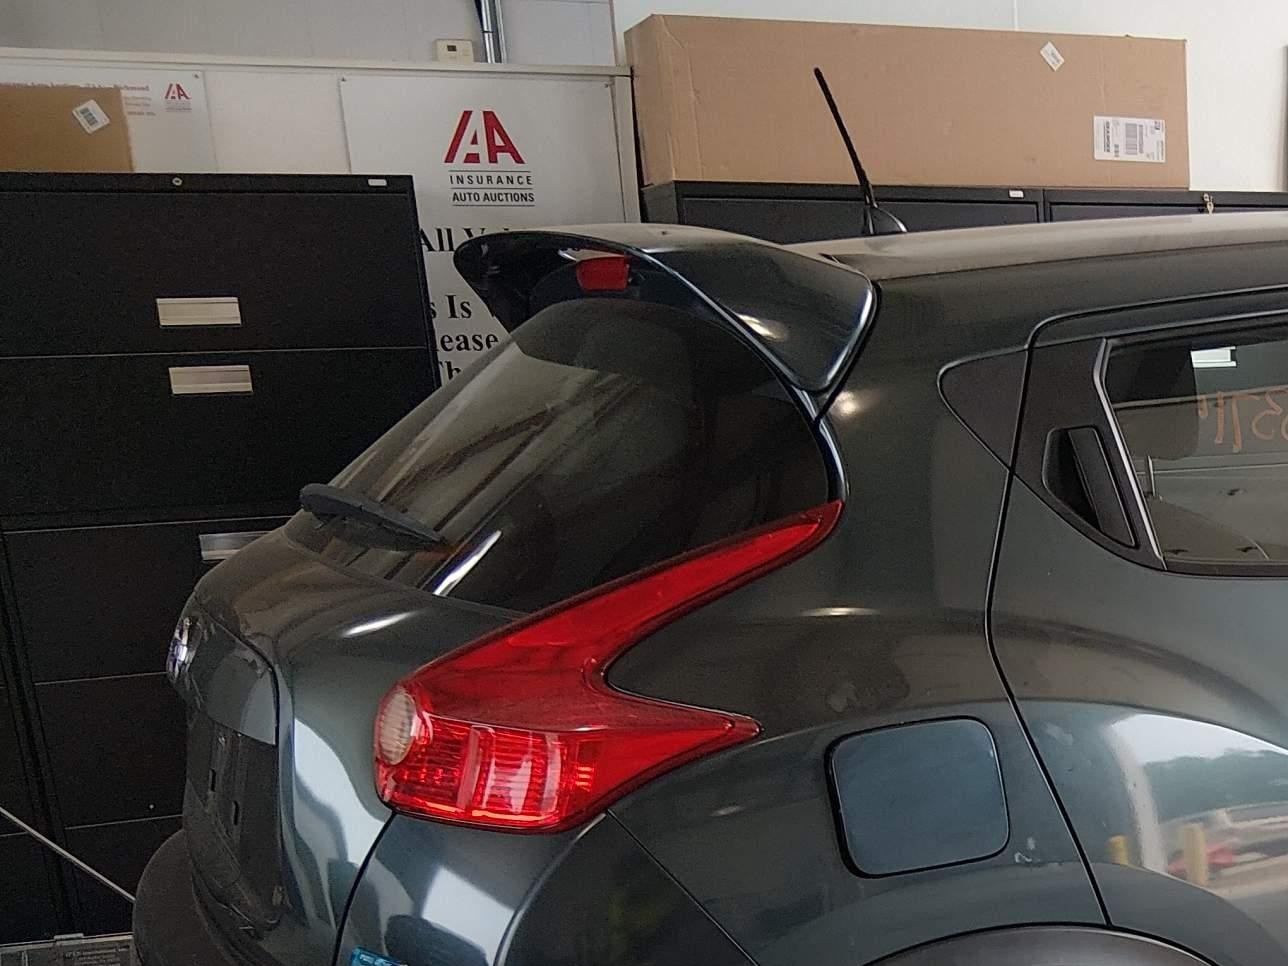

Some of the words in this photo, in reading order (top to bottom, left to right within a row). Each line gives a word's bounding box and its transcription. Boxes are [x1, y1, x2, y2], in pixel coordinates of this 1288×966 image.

[449, 175, 533, 185] INSURANCE
[452, 192, 480, 202] AUTO
[482, 192, 535, 203] AUCTIONS
